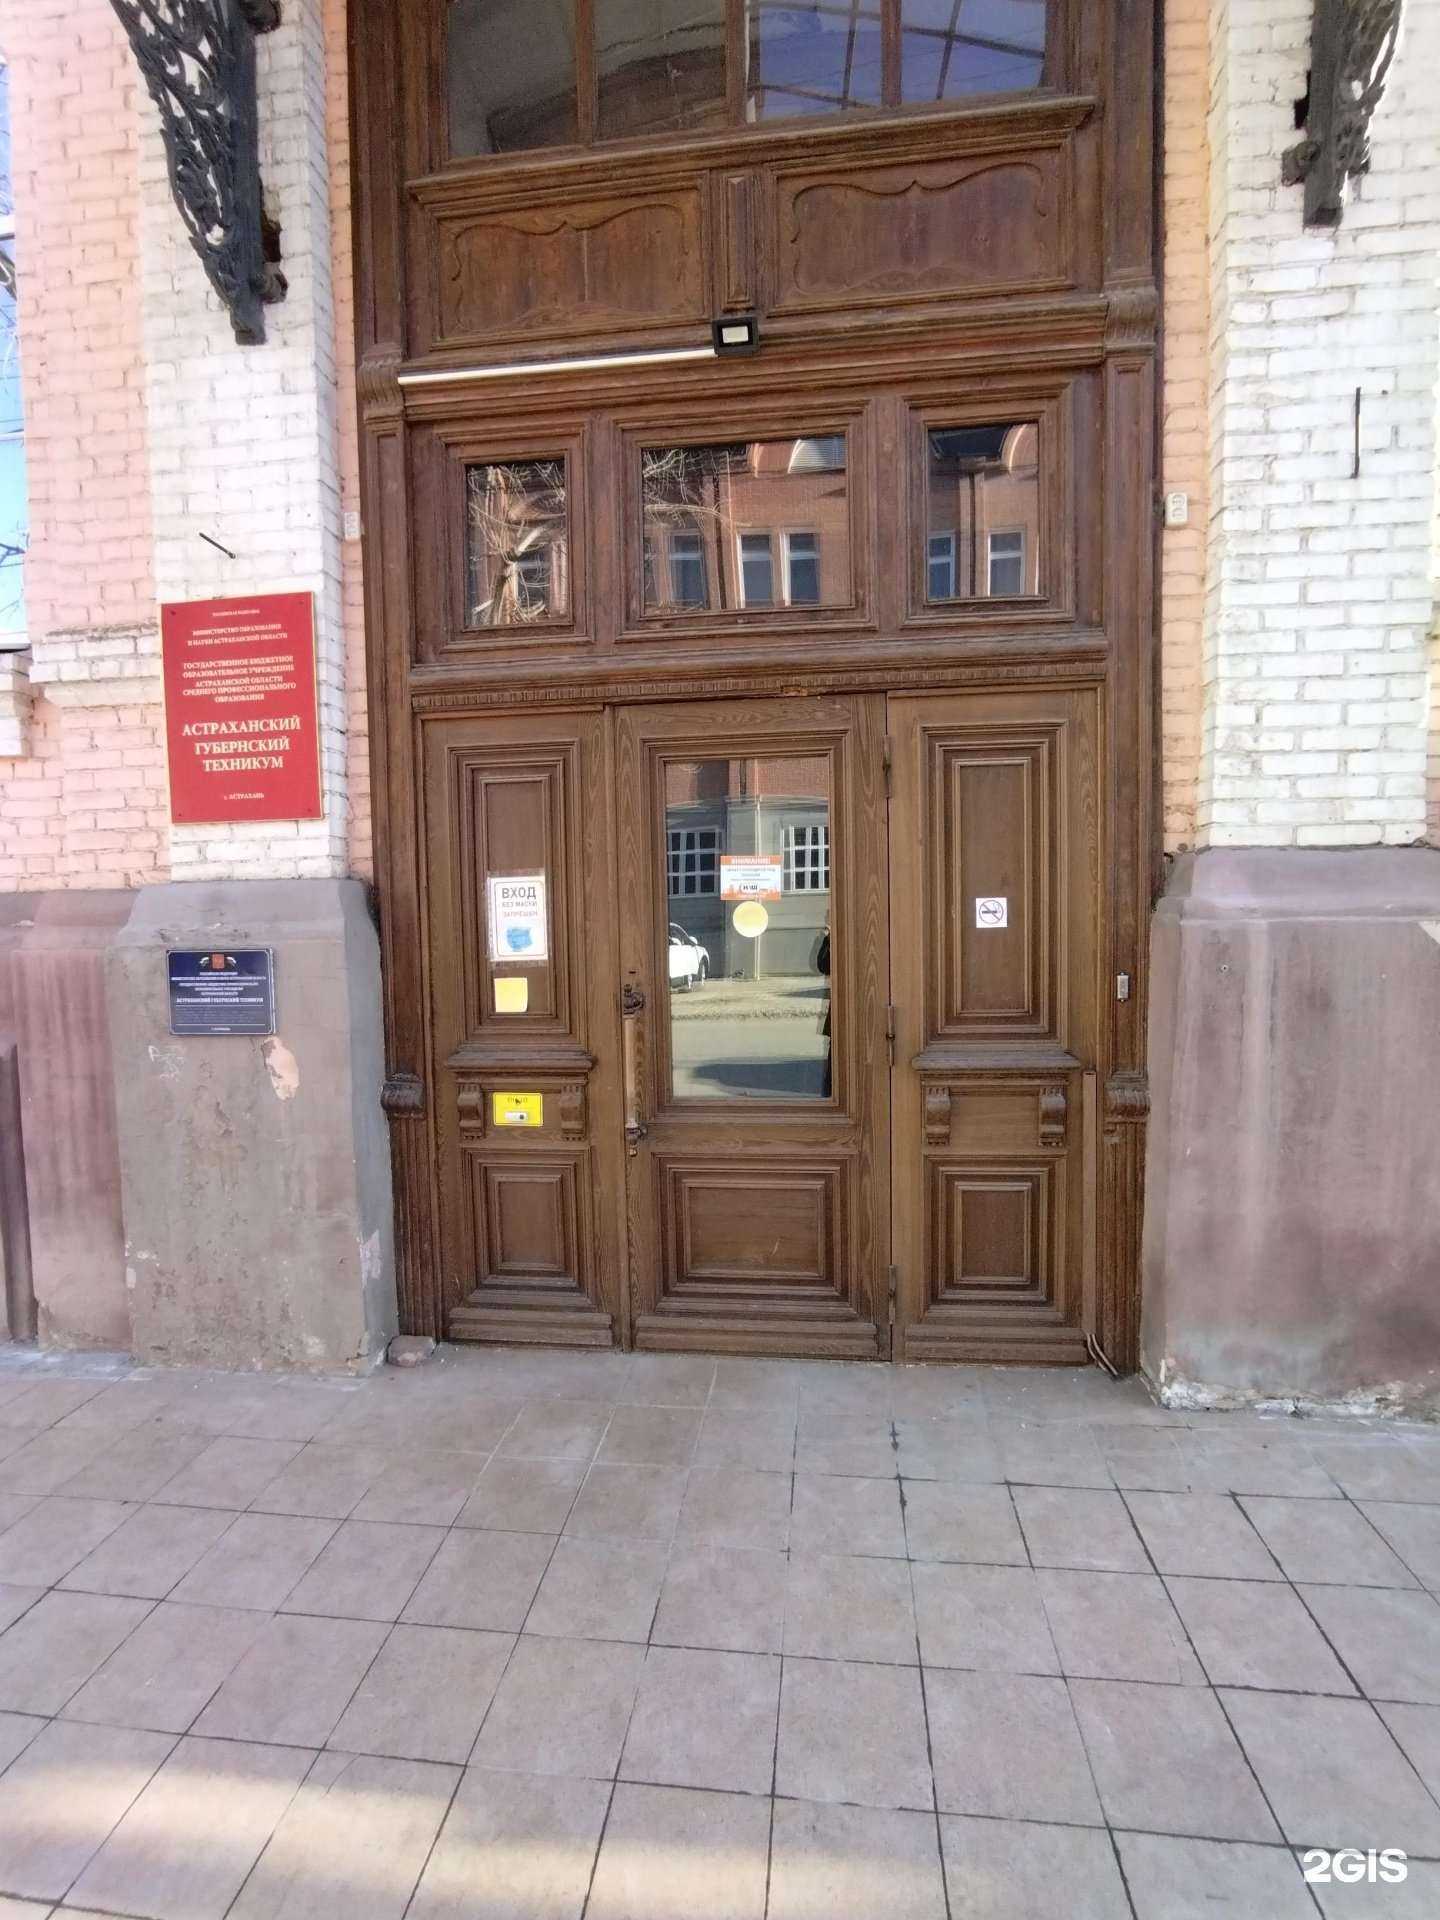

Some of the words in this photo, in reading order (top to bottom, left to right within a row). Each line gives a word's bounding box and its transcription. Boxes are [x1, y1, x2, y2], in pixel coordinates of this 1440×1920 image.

[183, 659, 248, 670] ГОСУДАРСТВЕННОЕ
[182, 668, 248, 679] ОБРАЗОВАТЕЛЬНОЕ
[195, 677, 250, 688] АСТРАХАНСКОЙ
[250, 675, 283, 684] ОБЛАСТИ
[182, 686, 217, 696] СРЕДНЕГО
[217, 682, 297, 694] ПРОФЕССИОНАЛЬНОГО
[214, 693, 265, 703] ОБРАЗОВАНИЯ
[182, 715, 302, 737] АСТРАХАНСКИЙ
[194, 736, 290, 755] ГУБЕРНСКИЙ
[203, 756, 284, 772] ТЕХНИКУМ
[502, 886, 537, 900] ВХОД
